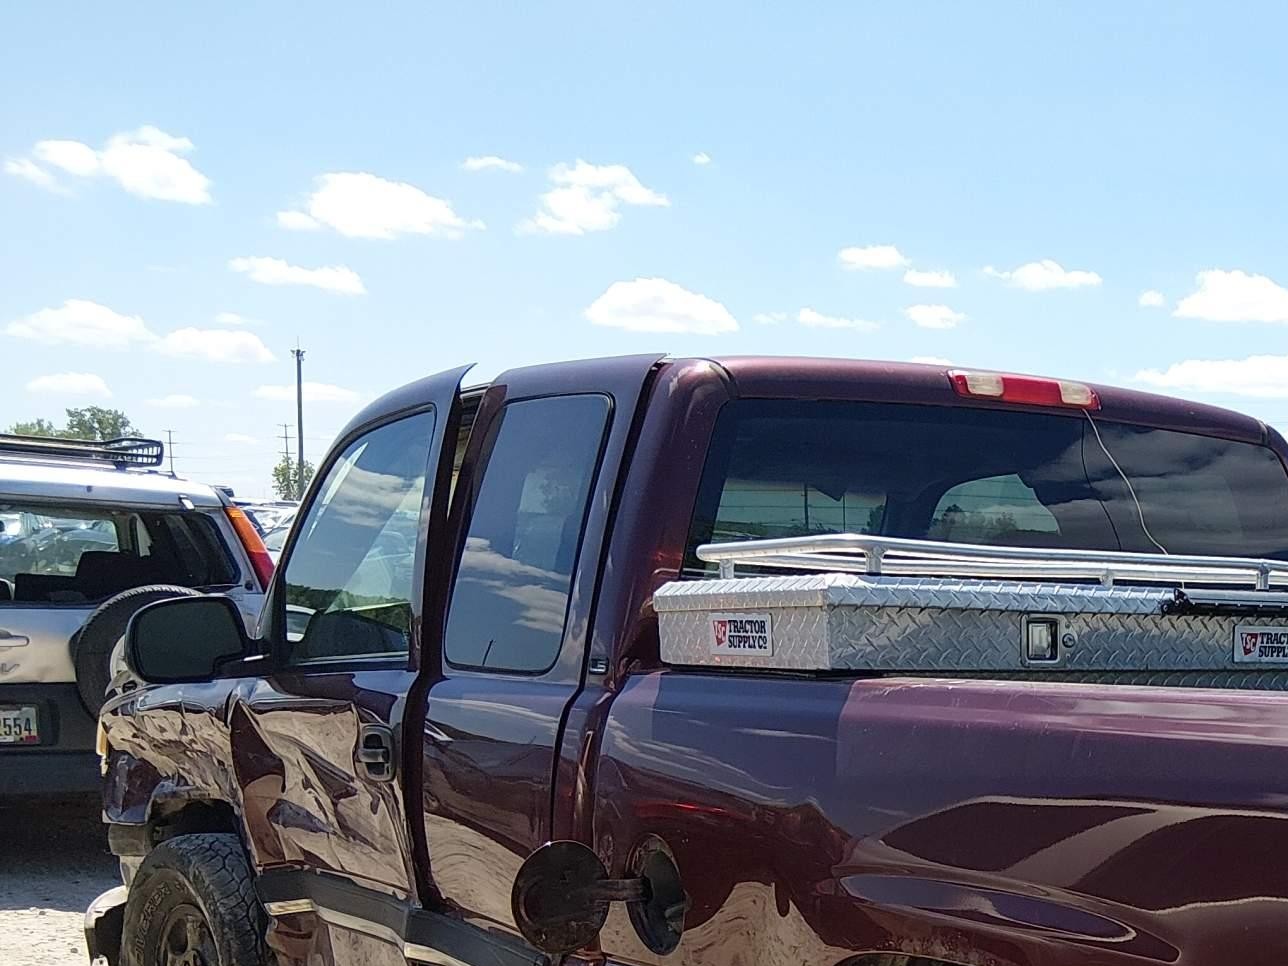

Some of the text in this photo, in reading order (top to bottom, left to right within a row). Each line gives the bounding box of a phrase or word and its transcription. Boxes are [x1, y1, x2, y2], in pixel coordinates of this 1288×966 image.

[728, 619, 768, 635] TRACTOR
[727, 634, 757, 650] SUPPLY
[0, 717, 32, 736] 554
